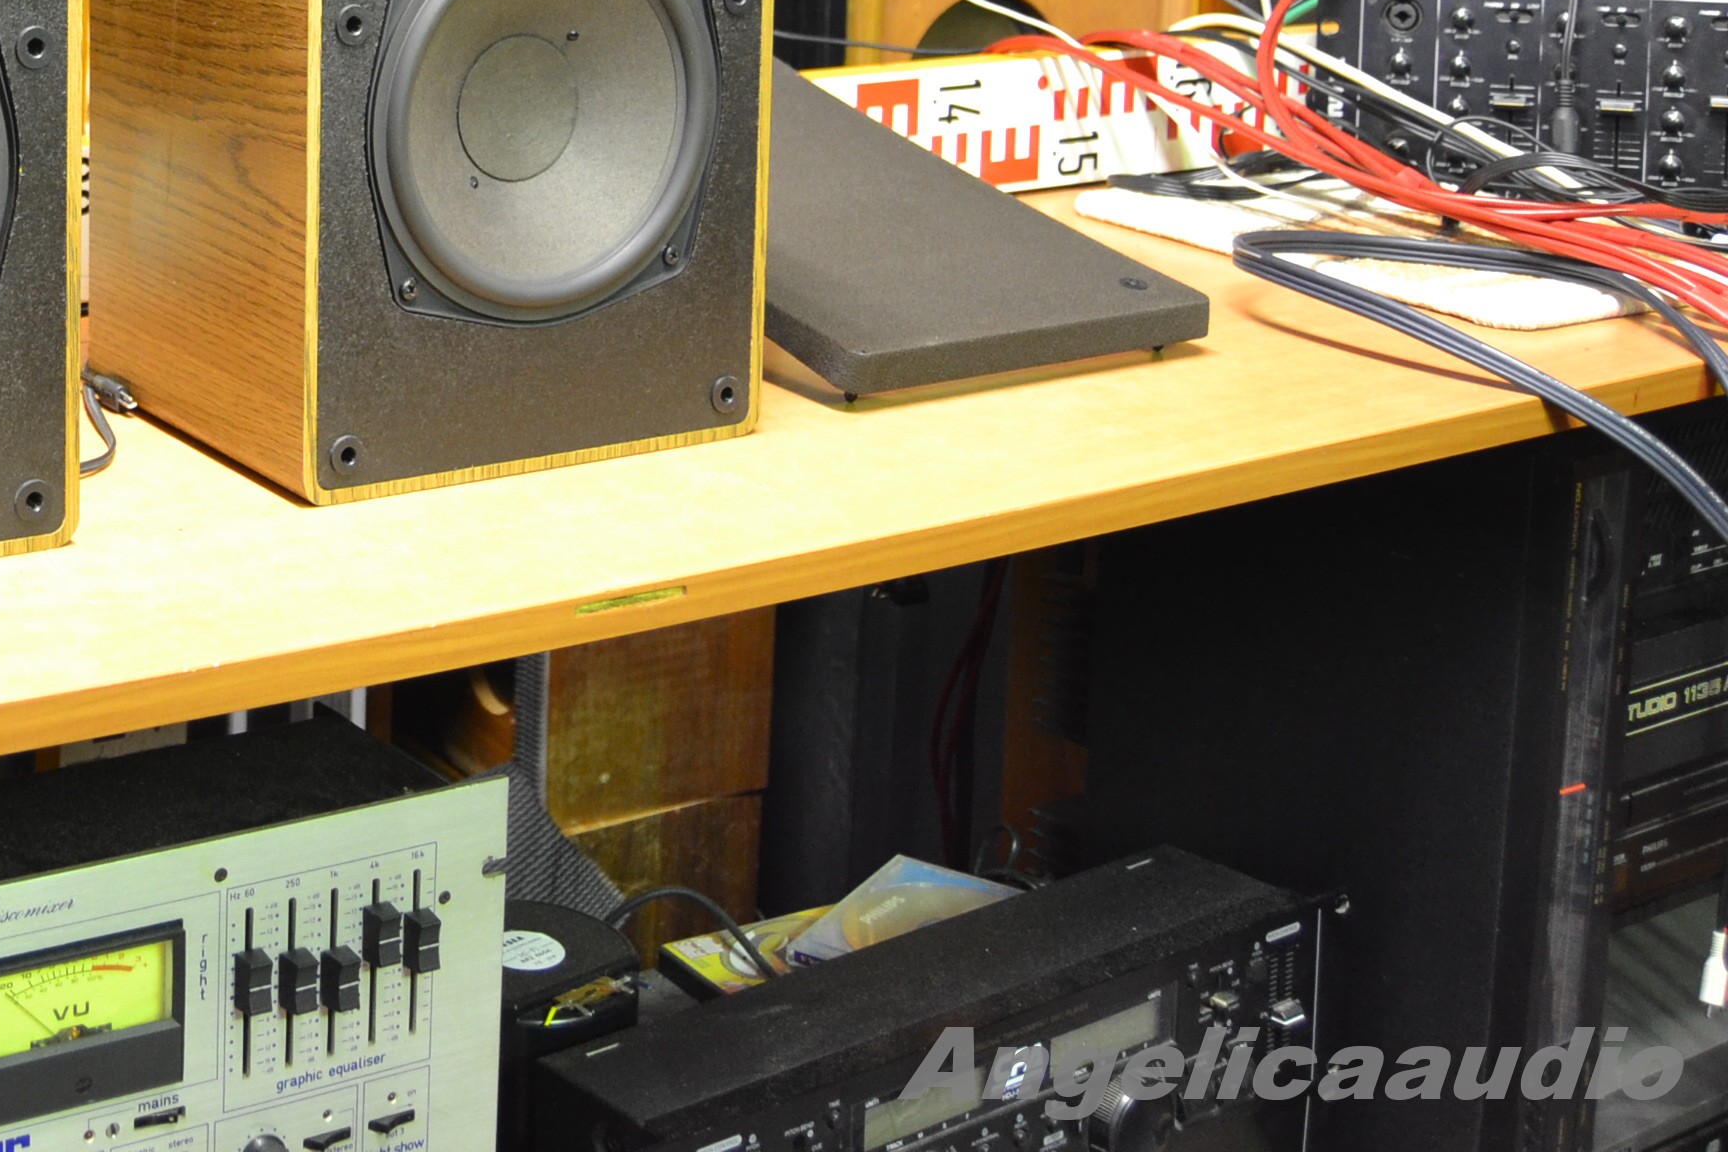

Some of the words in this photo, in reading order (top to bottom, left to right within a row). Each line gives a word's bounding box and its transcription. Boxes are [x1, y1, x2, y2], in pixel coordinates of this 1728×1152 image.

[411, 851, 424, 859] 16k
[370, 861, 379, 869] 4k
[330, 870, 339, 878] 1k
[285, 878, 301, 888] 250
[229, 891, 241, 901] Hz
[244, 888, 255, 898] 60
[0, 982, 14, 991] 20
[53, 1001, 90, 1021] VU
[276, 1070, 322, 1094] graphic
[328, 1053, 386, 1078] equaliser
[407, 1089, 416, 1097] on
[137, 1093, 179, 1114] mains
[168, 1136, 194, 1149] stereo
[886, 1140, 903, 1151] TRACK
